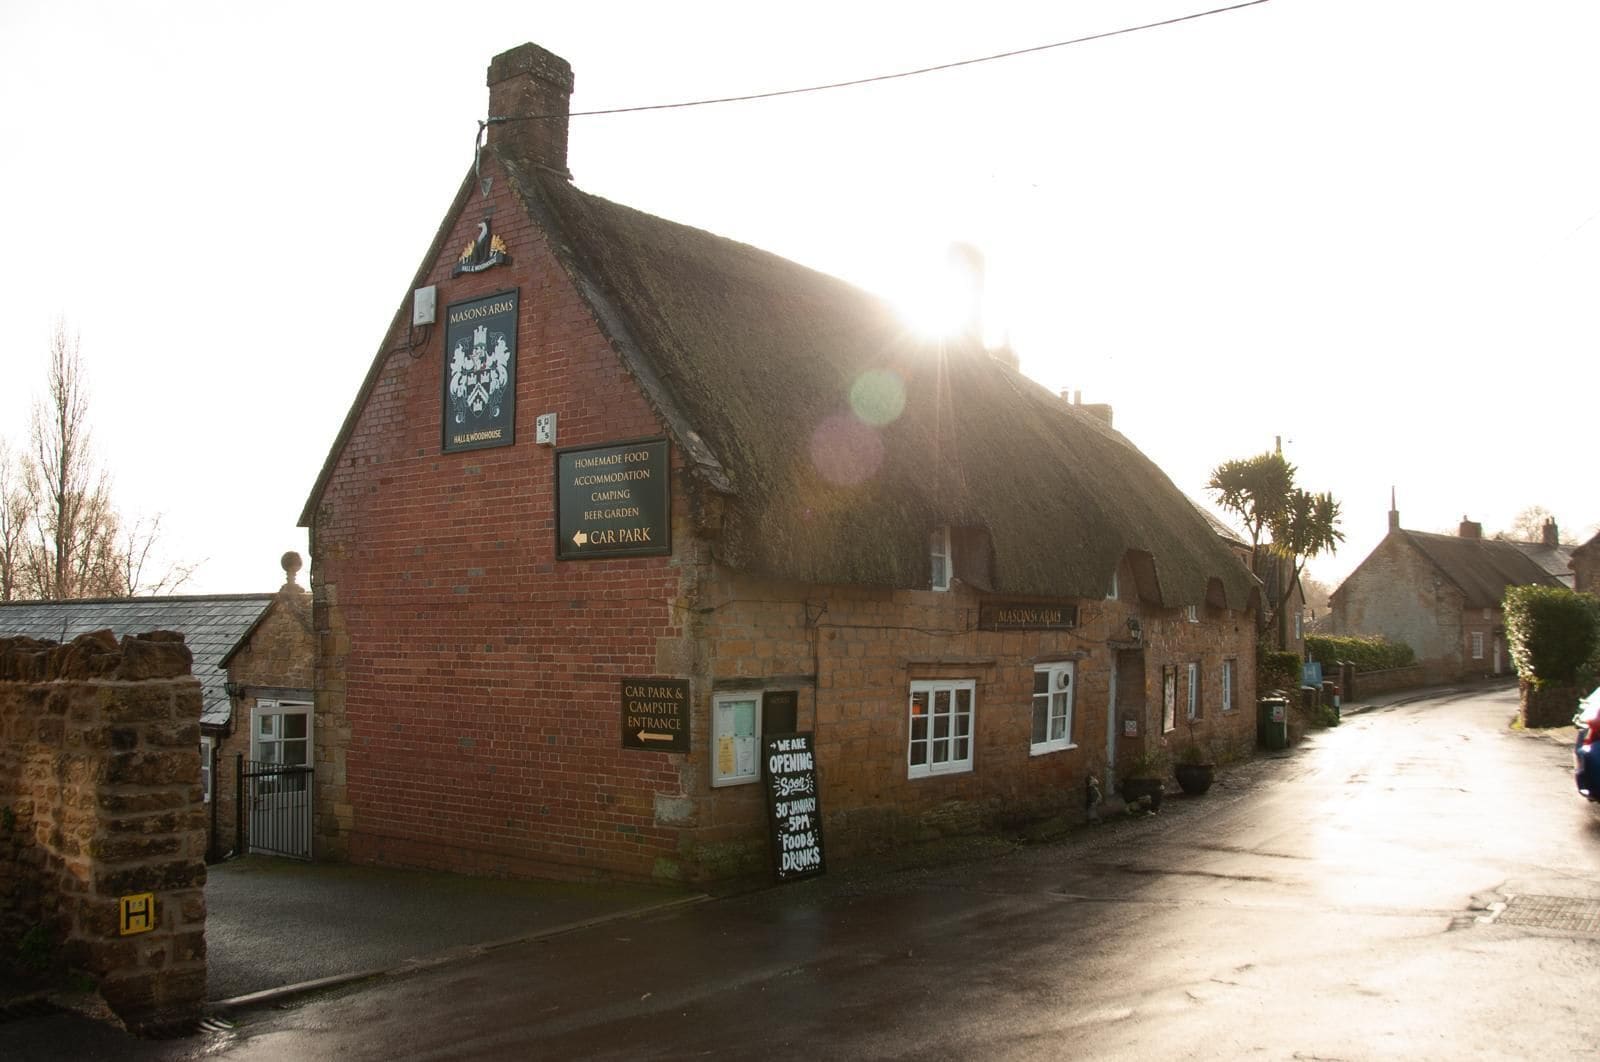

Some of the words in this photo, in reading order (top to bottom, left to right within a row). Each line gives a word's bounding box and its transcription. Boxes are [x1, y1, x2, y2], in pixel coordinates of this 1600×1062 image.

[450, 305, 487, 324] MASONS
[488, 300, 513, 315] ARMS
[453, 434, 465, 444] HALL
[575, 454, 622, 469] HOMEMADE
[624, 451, 649, 463] FOOD
[574, 469, 650, 486] ACCOMMODATION
[591, 489, 631, 501] CAMPING
[584, 511, 603, 520] BEER
[604, 507, 639, 519] GARDEN
[590, 530, 616, 544] CAR
[619, 527, 651, 543] PARK
[625, 686, 646, 698] CAR
[648, 687, 673, 699] PARK
[675, 687, 684, 699] &
[629, 700, 679, 715] CAMPSITE
[628, 715, 681, 730] ENTRANCE
[777, 739, 790, 751] WE
[791, 737, 807, 750] ARE
[769, 752, 813, 774] OPENING
[789, 814, 810, 832] 5PM
[782, 833, 806, 851] FOOD
[806, 831, 815, 847] &
[782, 846, 821, 872] DRINKS
[125, 897, 150, 930] H
